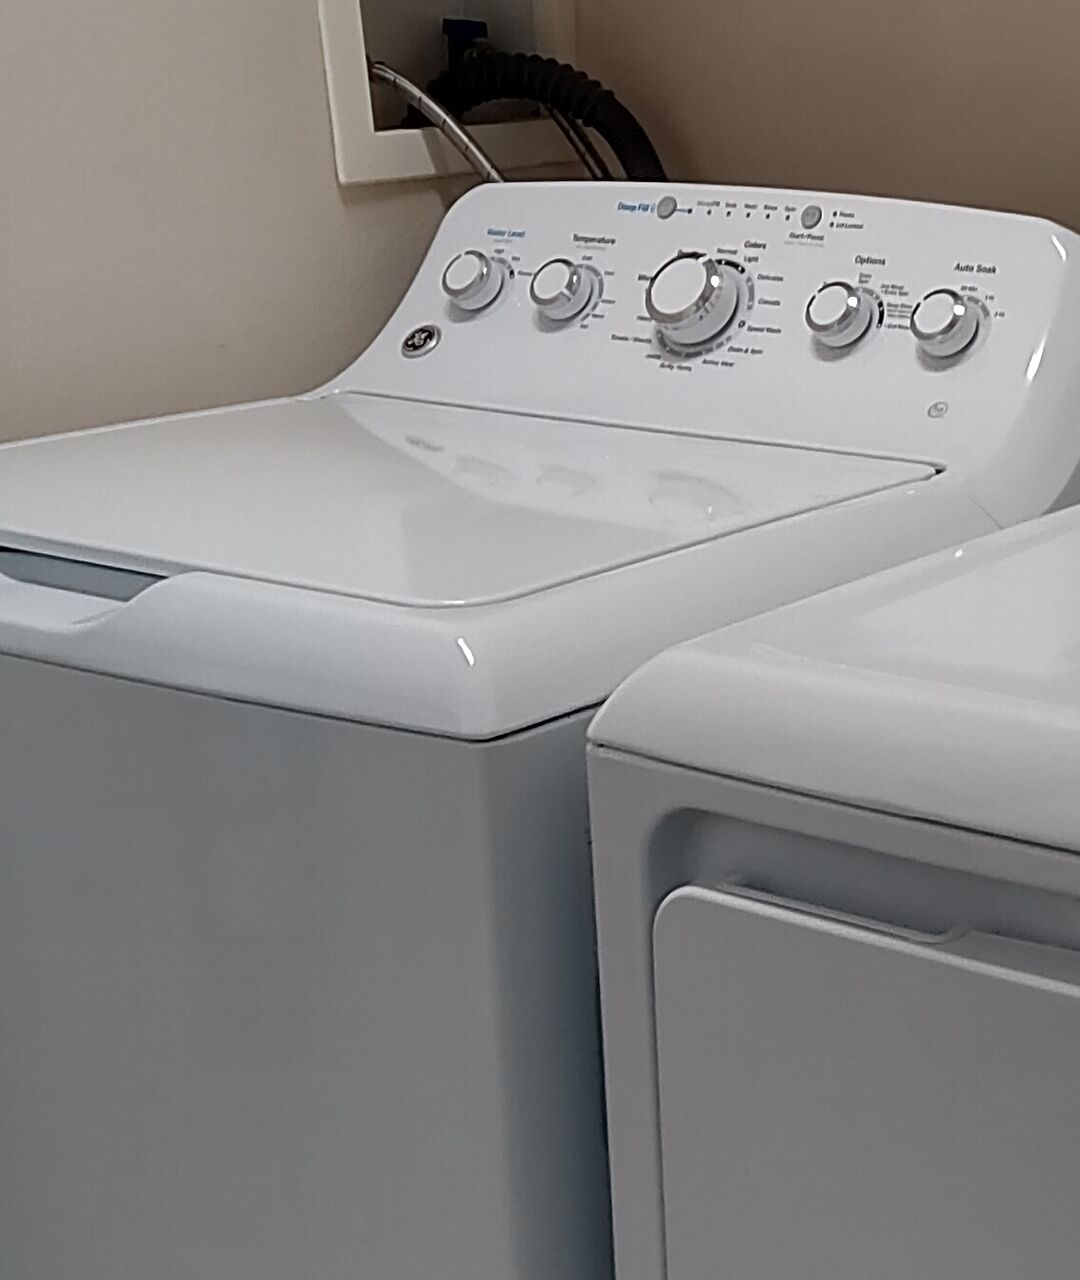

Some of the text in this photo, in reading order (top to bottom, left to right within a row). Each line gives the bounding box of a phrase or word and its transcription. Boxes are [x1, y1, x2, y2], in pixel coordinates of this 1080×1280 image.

[854, 255, 886, 266] Options
[953, 262, 997, 274] Auto Soak
